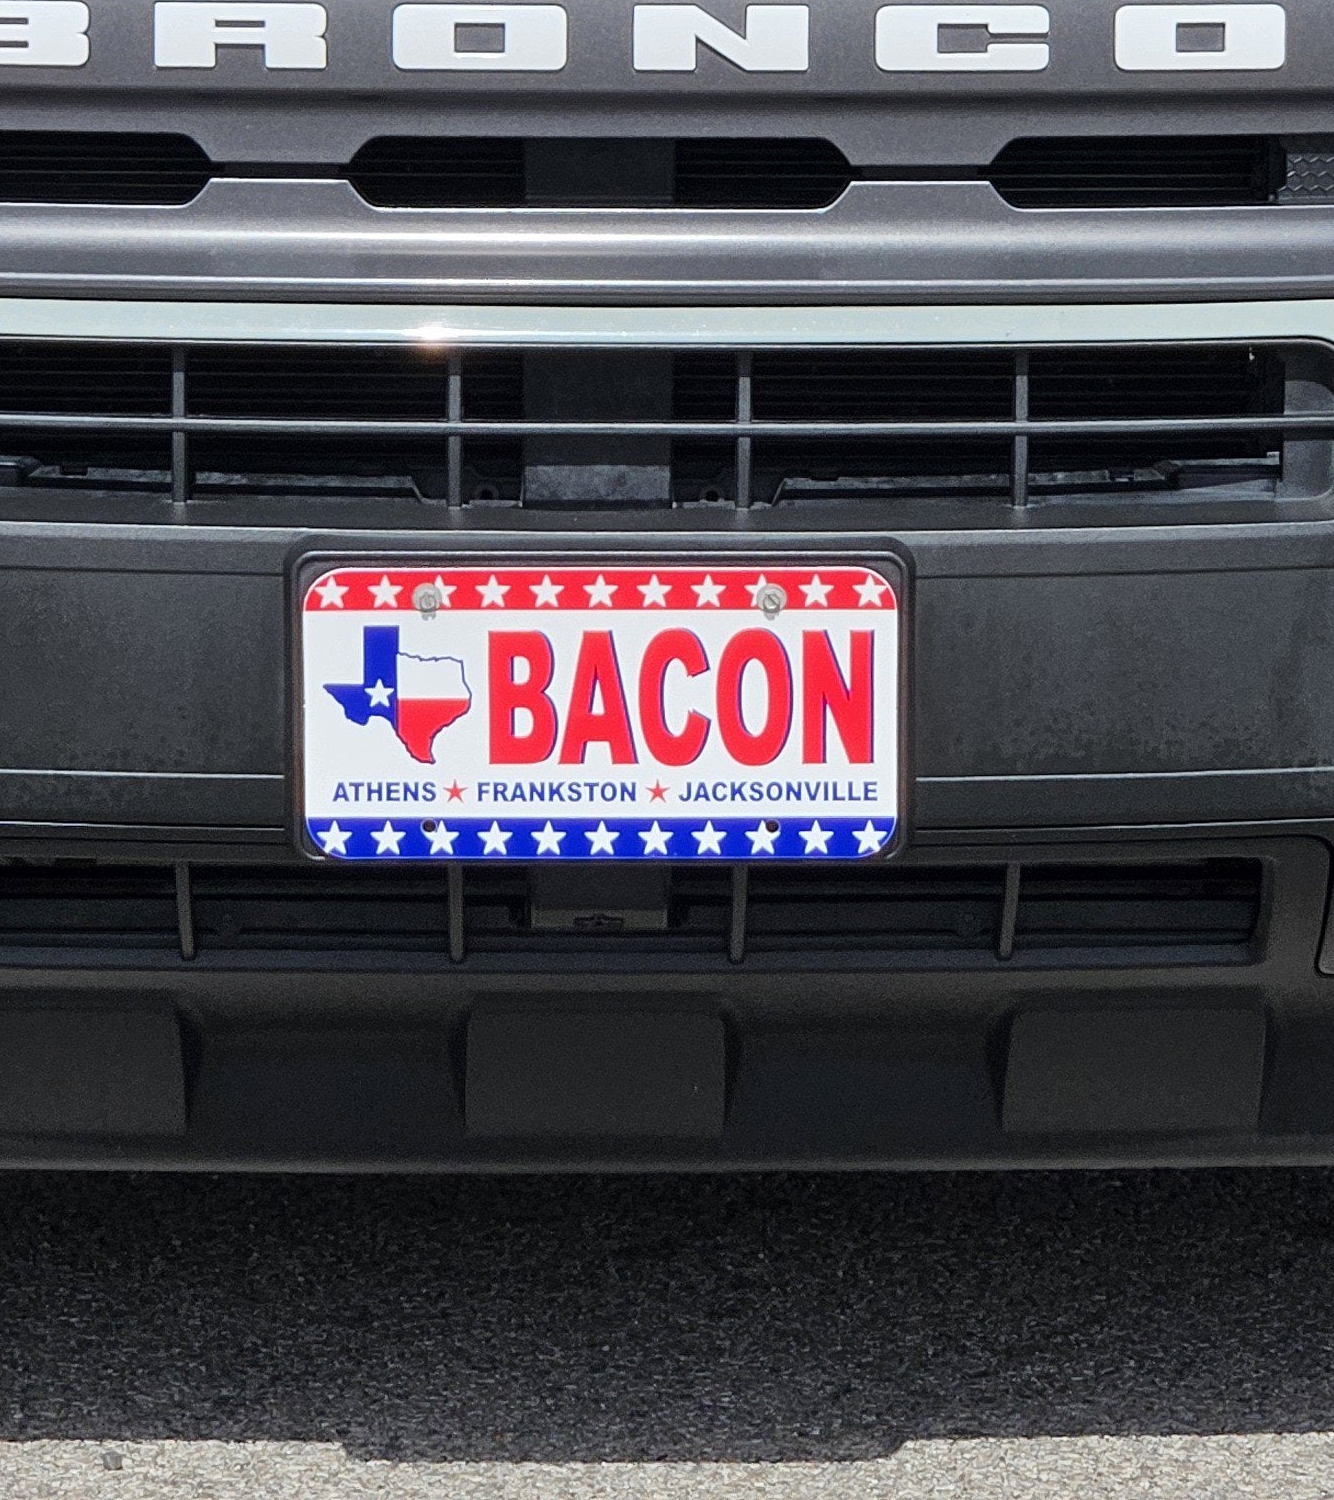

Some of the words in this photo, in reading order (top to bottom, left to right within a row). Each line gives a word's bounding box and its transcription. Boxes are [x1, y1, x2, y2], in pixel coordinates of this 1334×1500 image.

[488, 628, 875, 766] BACON
[332, 782, 437, 802] ATHENS
[477, 782, 637, 802] FRANKSTON
[678, 781, 878, 803] JACKSONVILLE
